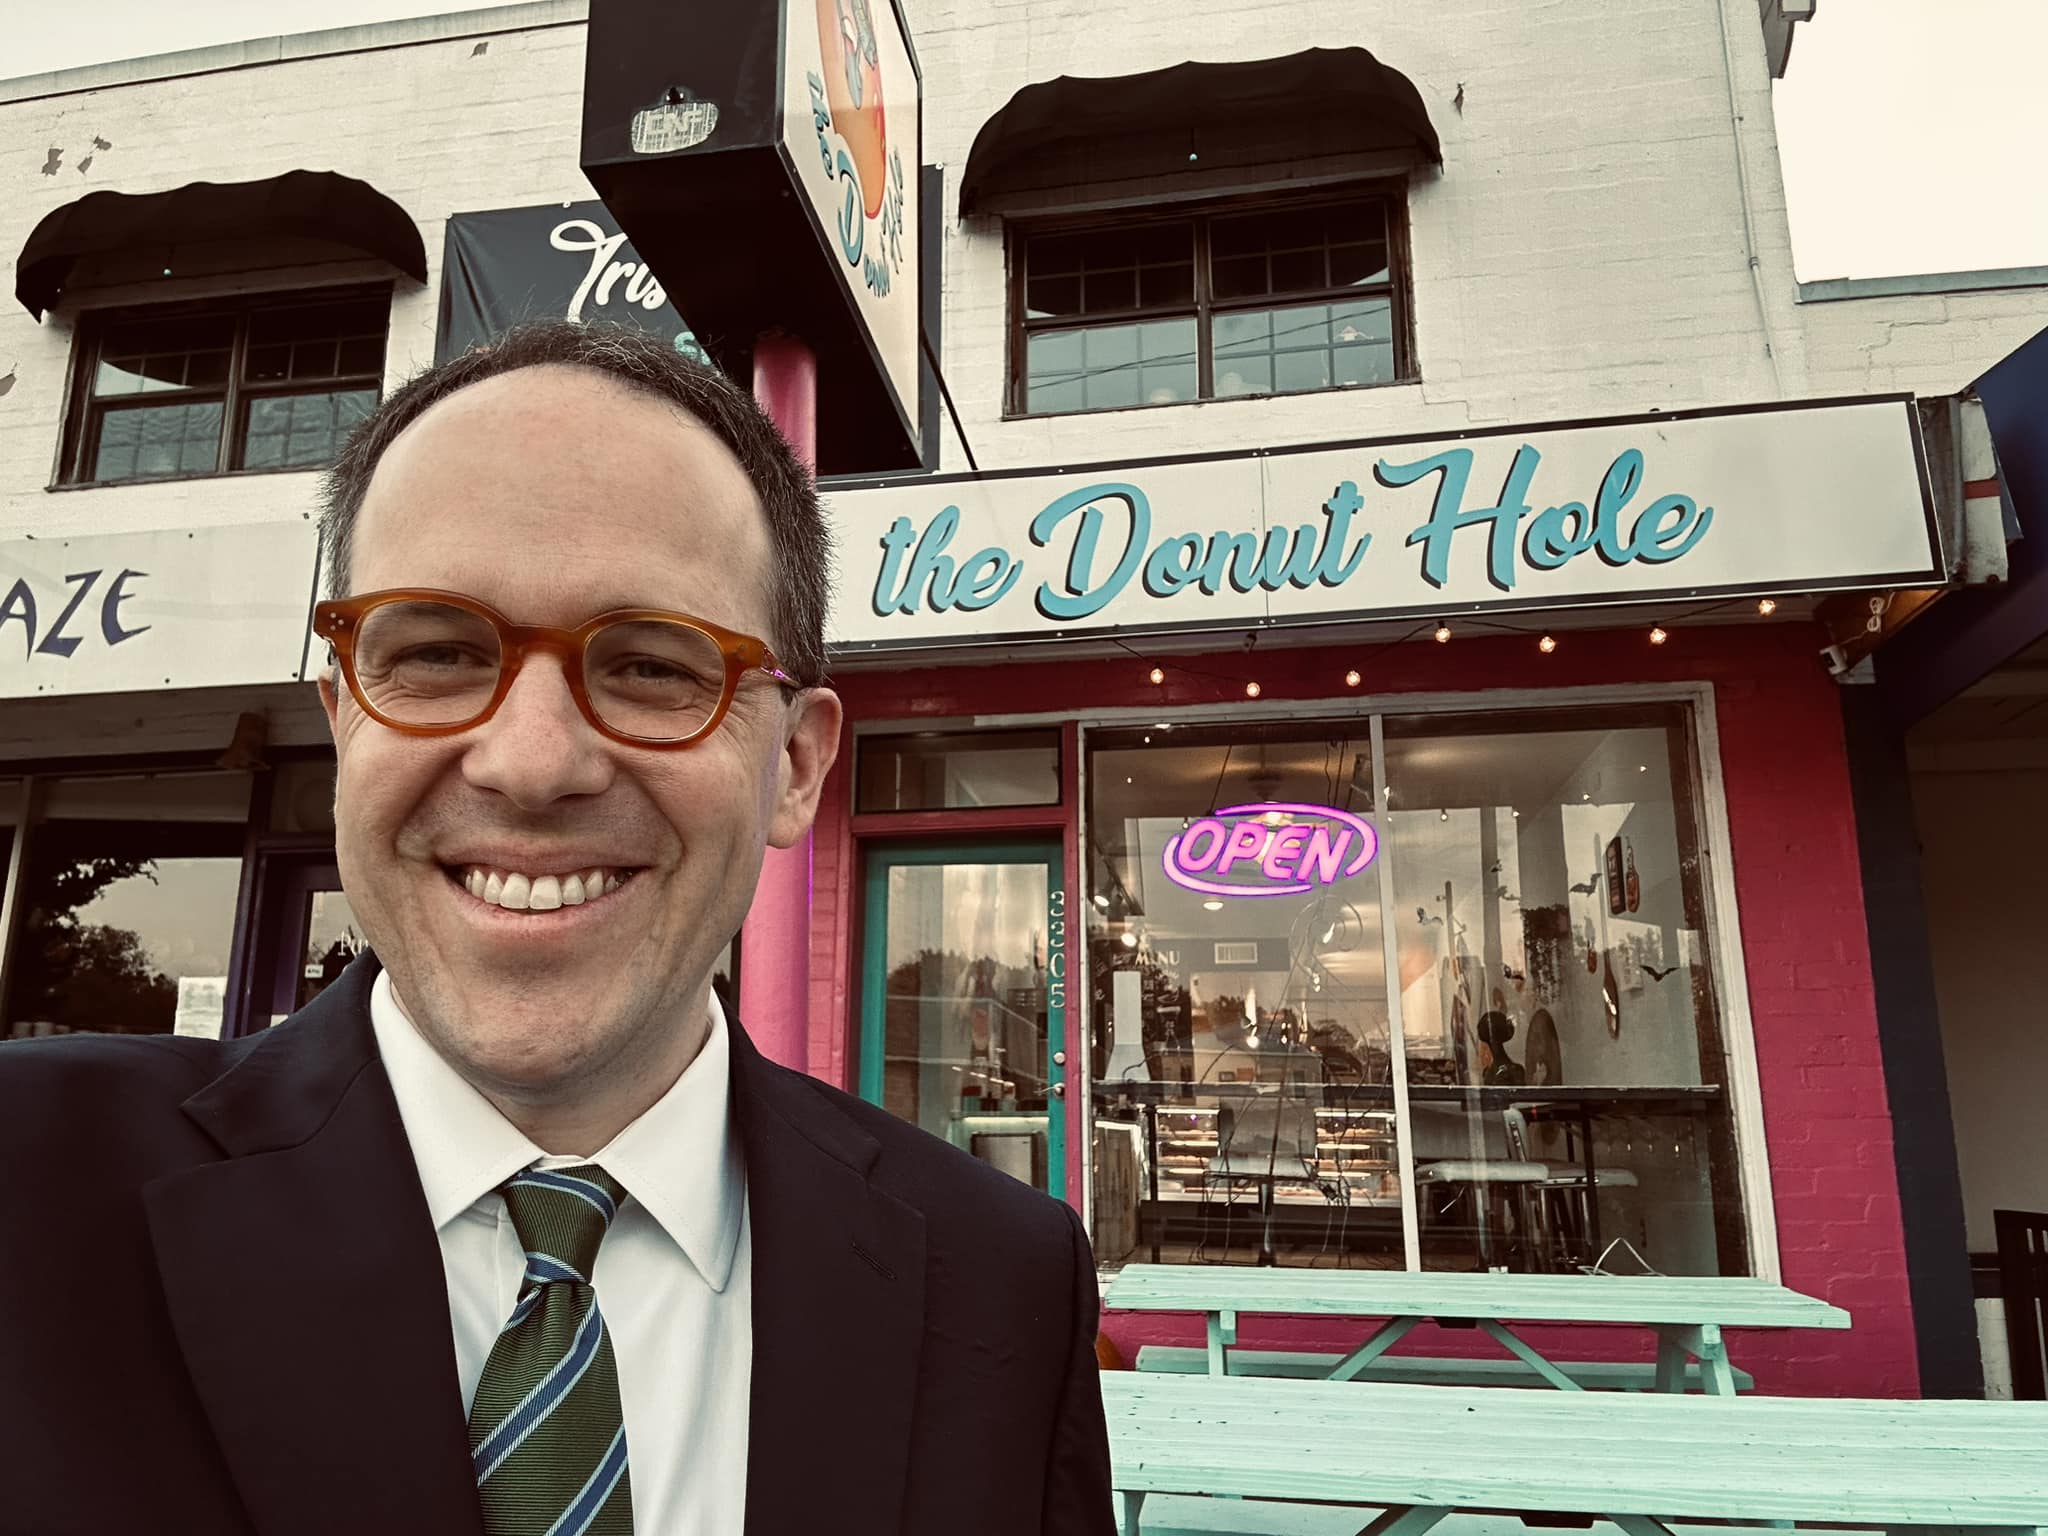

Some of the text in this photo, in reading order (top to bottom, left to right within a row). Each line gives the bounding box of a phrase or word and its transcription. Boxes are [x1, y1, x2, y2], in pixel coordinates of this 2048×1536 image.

[872, 443, 1715, 622] the Donut Hole
[0, 568, 153, 664] AZE
[1177, 818, 1354, 885] OPEN
